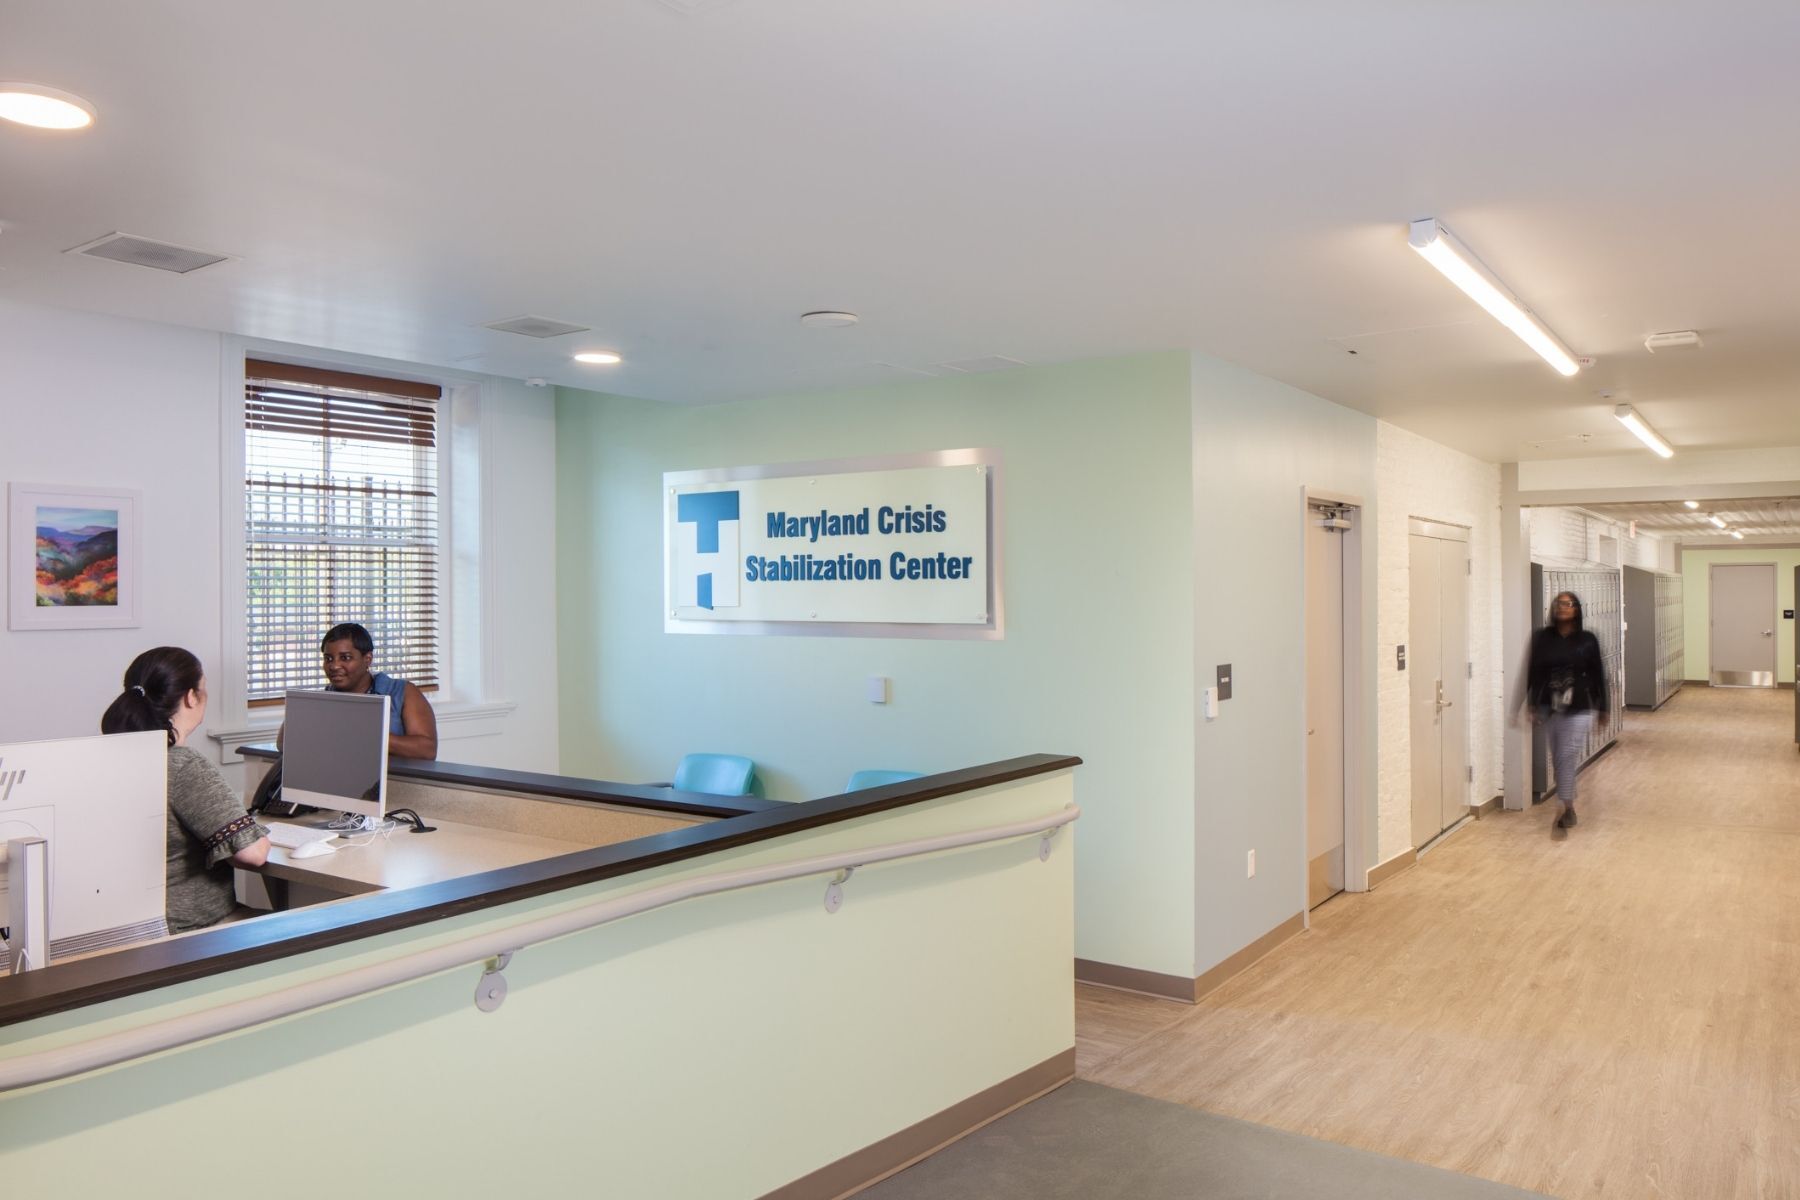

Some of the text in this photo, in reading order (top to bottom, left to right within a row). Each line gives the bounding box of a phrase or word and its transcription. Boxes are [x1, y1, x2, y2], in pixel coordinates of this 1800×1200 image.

[767, 504, 946, 543] Maryland Crisis
[745, 551, 972, 582] Stabilization Center
